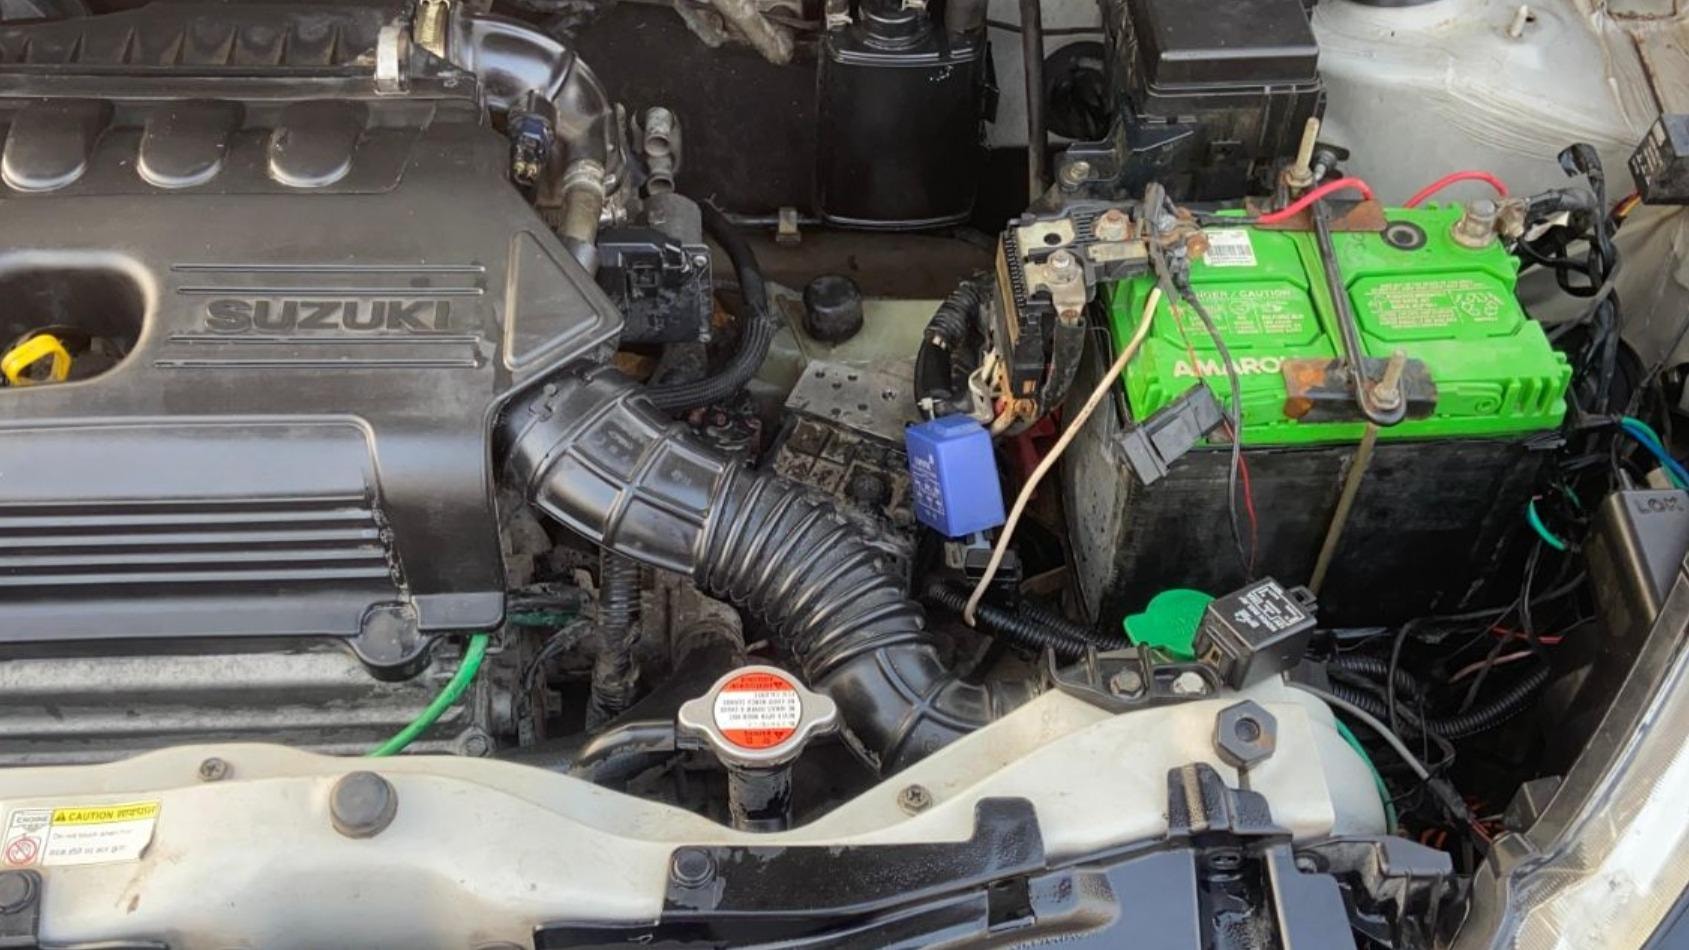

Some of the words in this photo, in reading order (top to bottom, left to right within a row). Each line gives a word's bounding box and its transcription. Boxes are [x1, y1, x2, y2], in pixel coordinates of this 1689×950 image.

[204, 298, 451, 333] SUZUKI
[1173, 356, 1285, 377] AMARO
[68, 810, 114, 822] CAUTION
